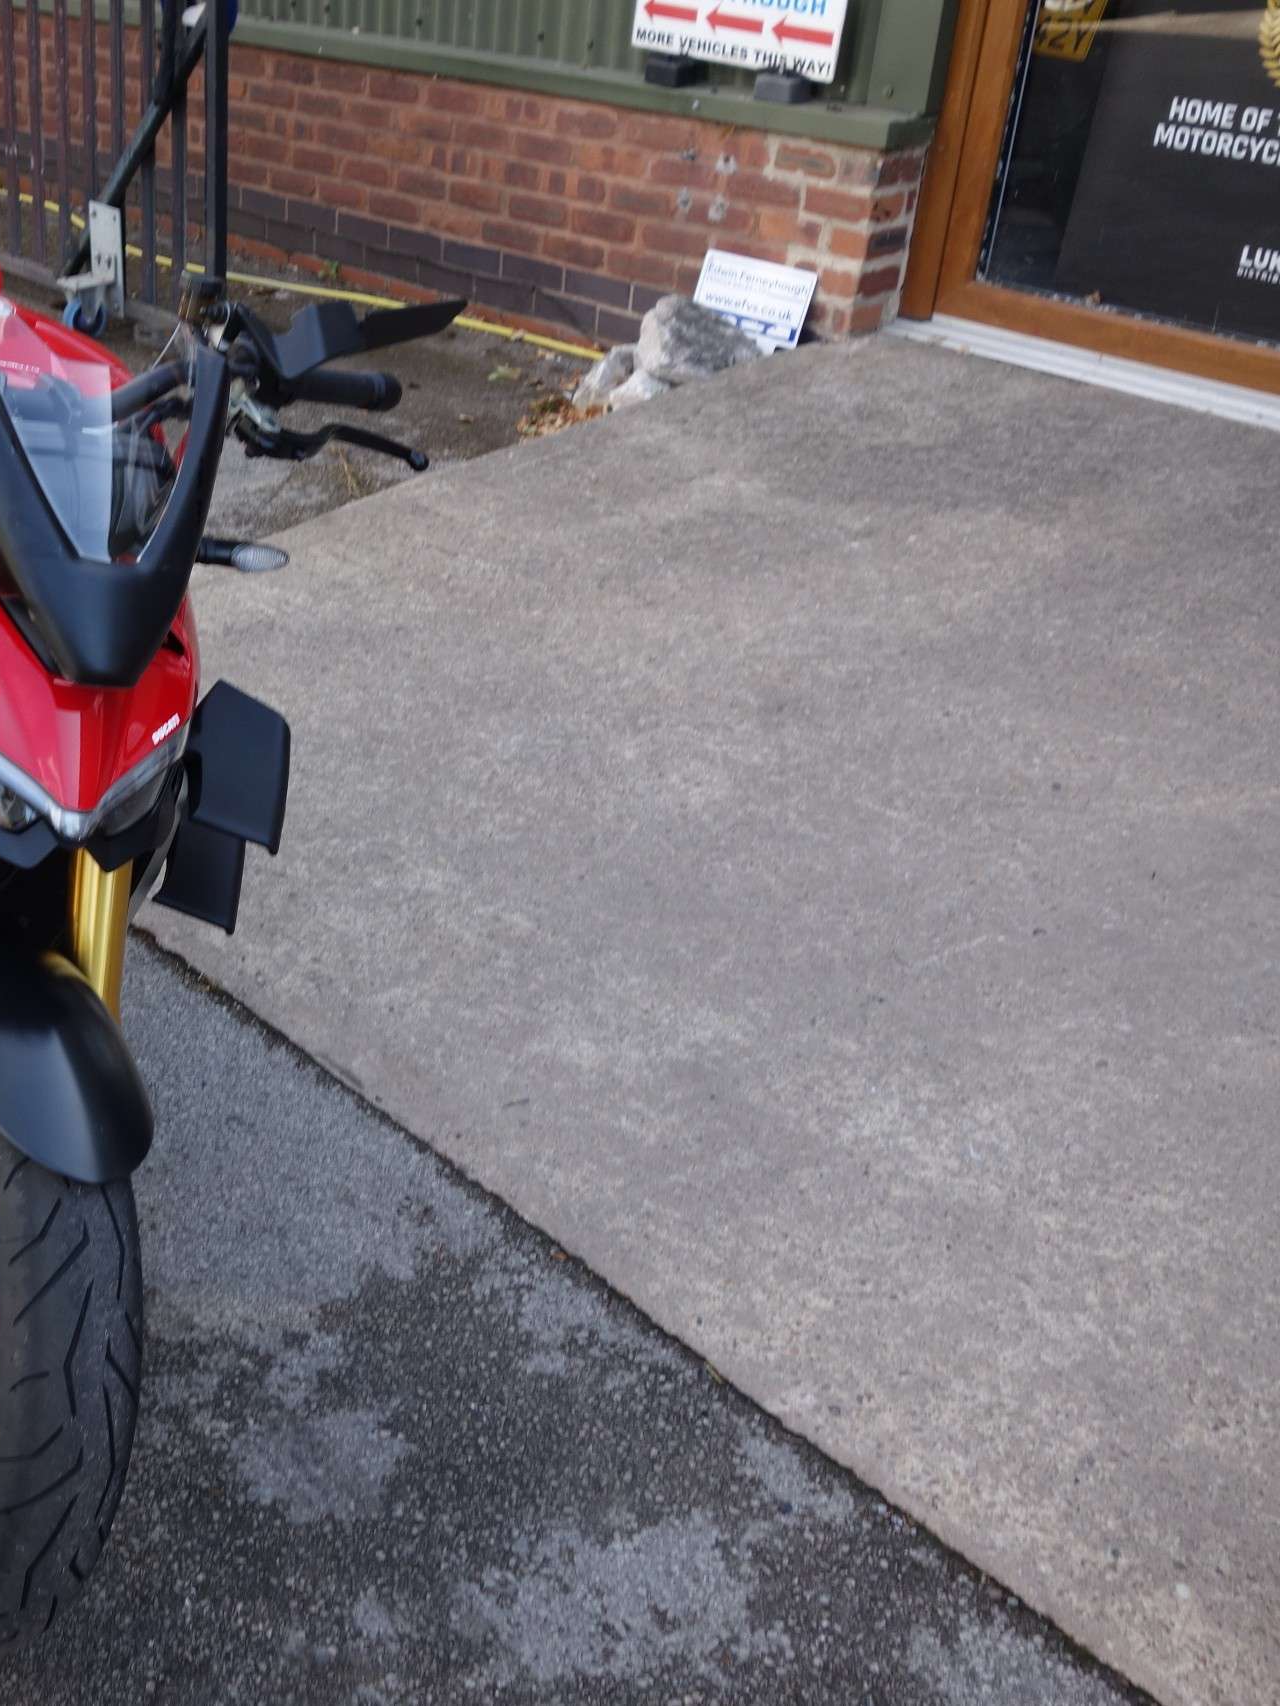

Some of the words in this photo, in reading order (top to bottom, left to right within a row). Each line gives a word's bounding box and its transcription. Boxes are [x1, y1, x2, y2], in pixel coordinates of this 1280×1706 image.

[636, 28, 673, 46] MORE
[679, 36, 748, 60] VEHICLES
[753, 49, 787, 68] THIS
[793, 58, 831, 76] WAY!
[1168, 95, 1238, 130] HOME
[1240, 106, 1274, 134] OF
[1152, 122, 1280, 167] MOTORCYC
